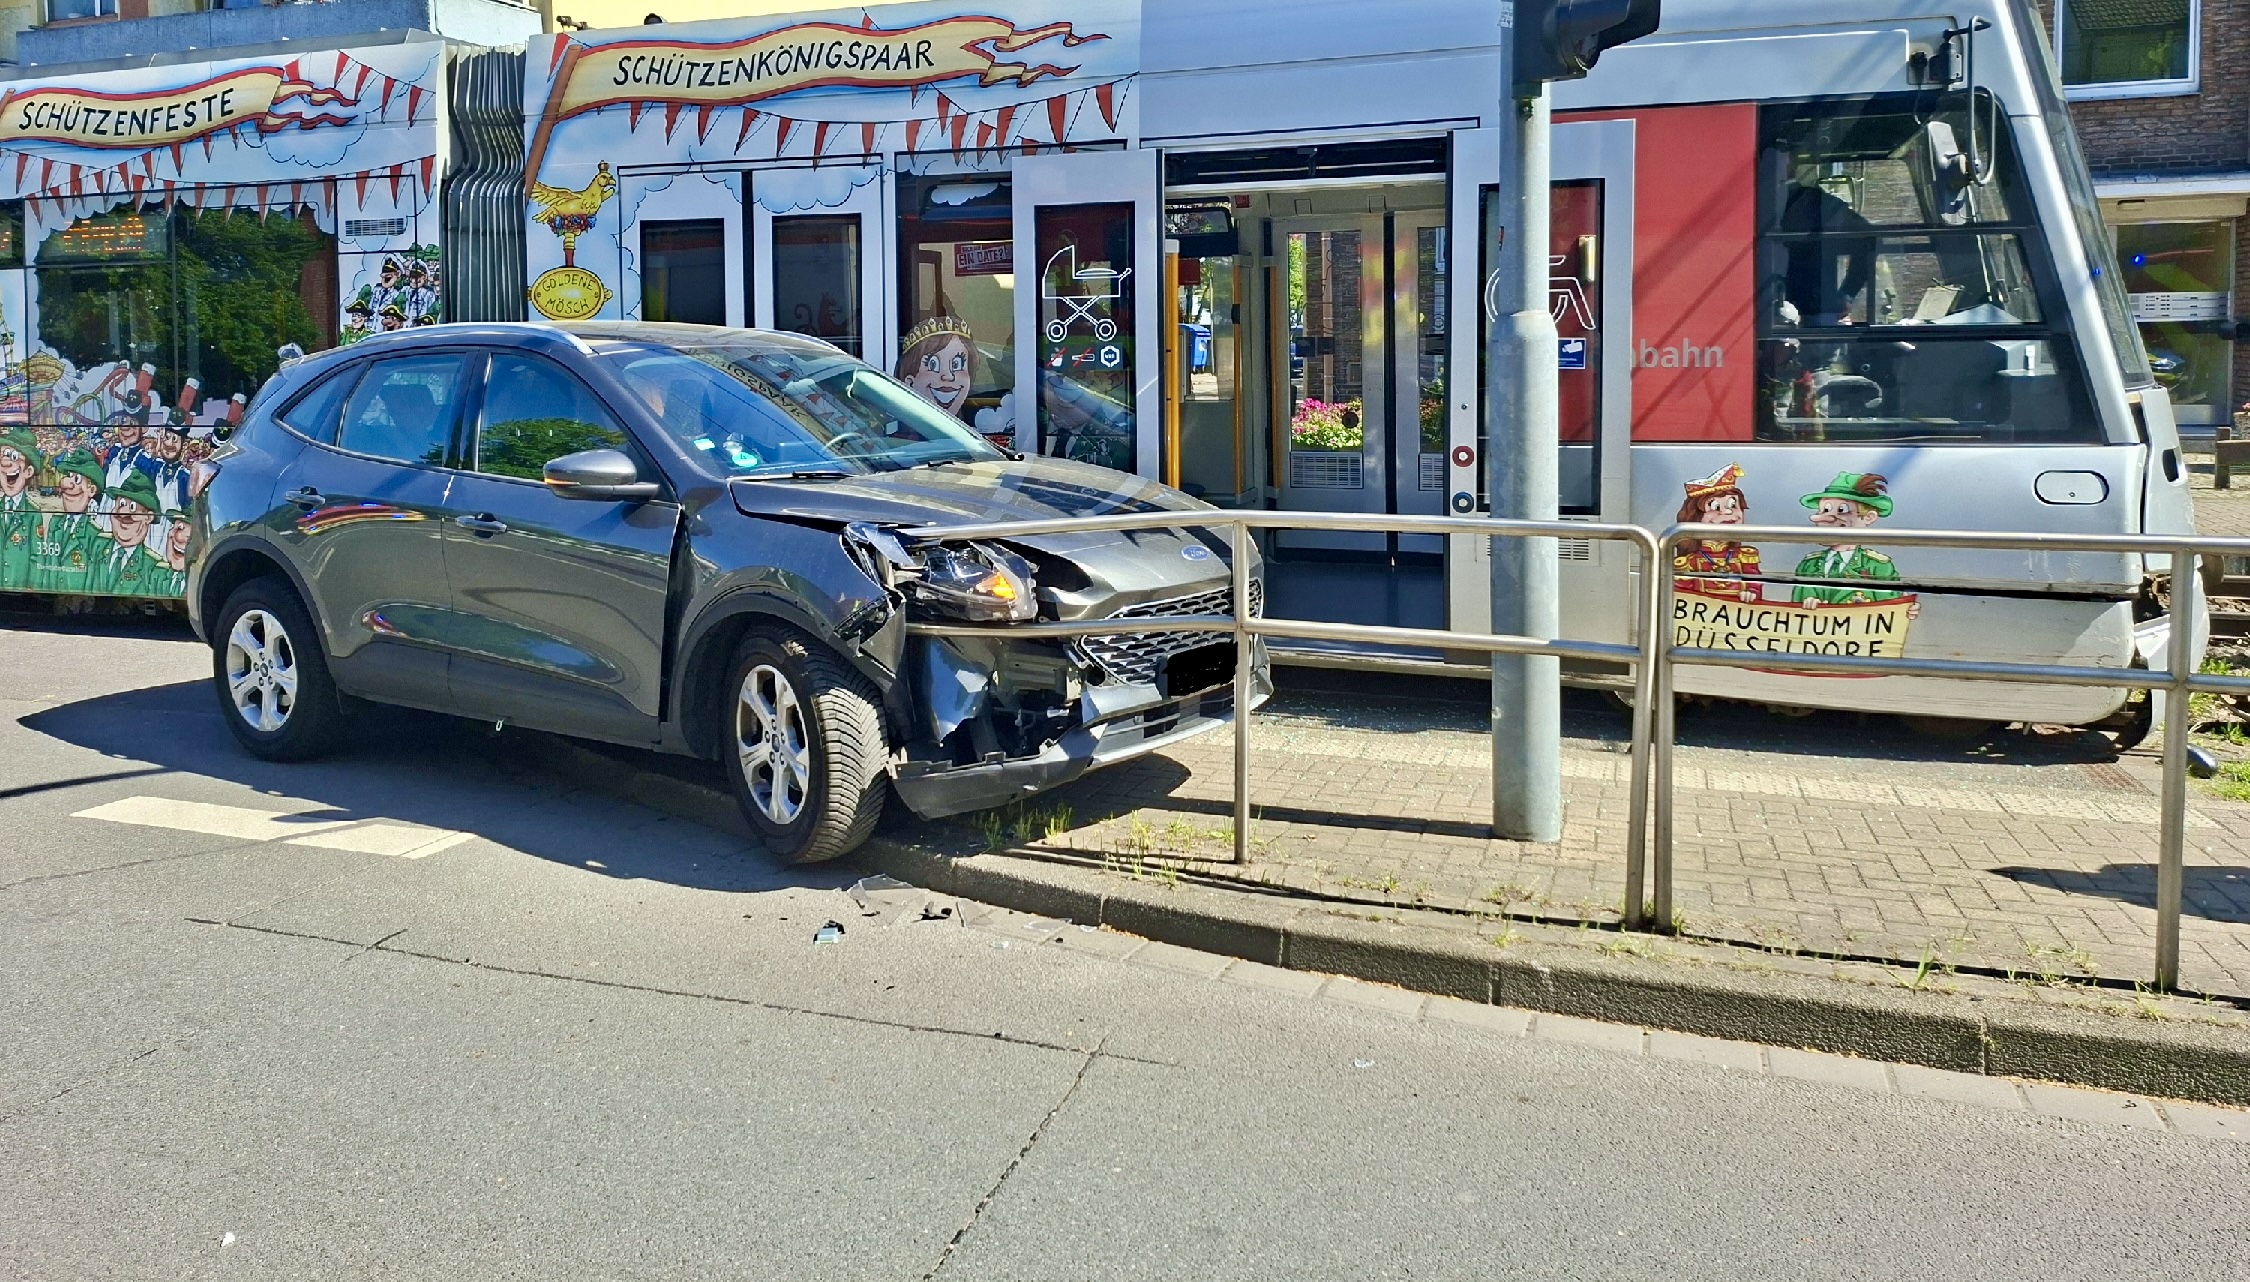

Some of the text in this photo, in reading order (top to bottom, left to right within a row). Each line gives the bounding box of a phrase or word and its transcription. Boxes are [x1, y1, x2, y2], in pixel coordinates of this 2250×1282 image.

[613, 39, 934, 88] SCHÜTZENKÖNIGSPAAR
[18, 87, 235, 136] SCHÜTZENFESTE
[959, 248, 1004, 265] EIN DATE?
[542, 273, 595, 292] GOLDENE
[545, 298, 590, 314] MÖSCH
[1632, 338, 1723, 368] bahn
[36, 541, 60, 556] 3369
[1673, 598, 1895, 635] BRAUCHTUM IN
